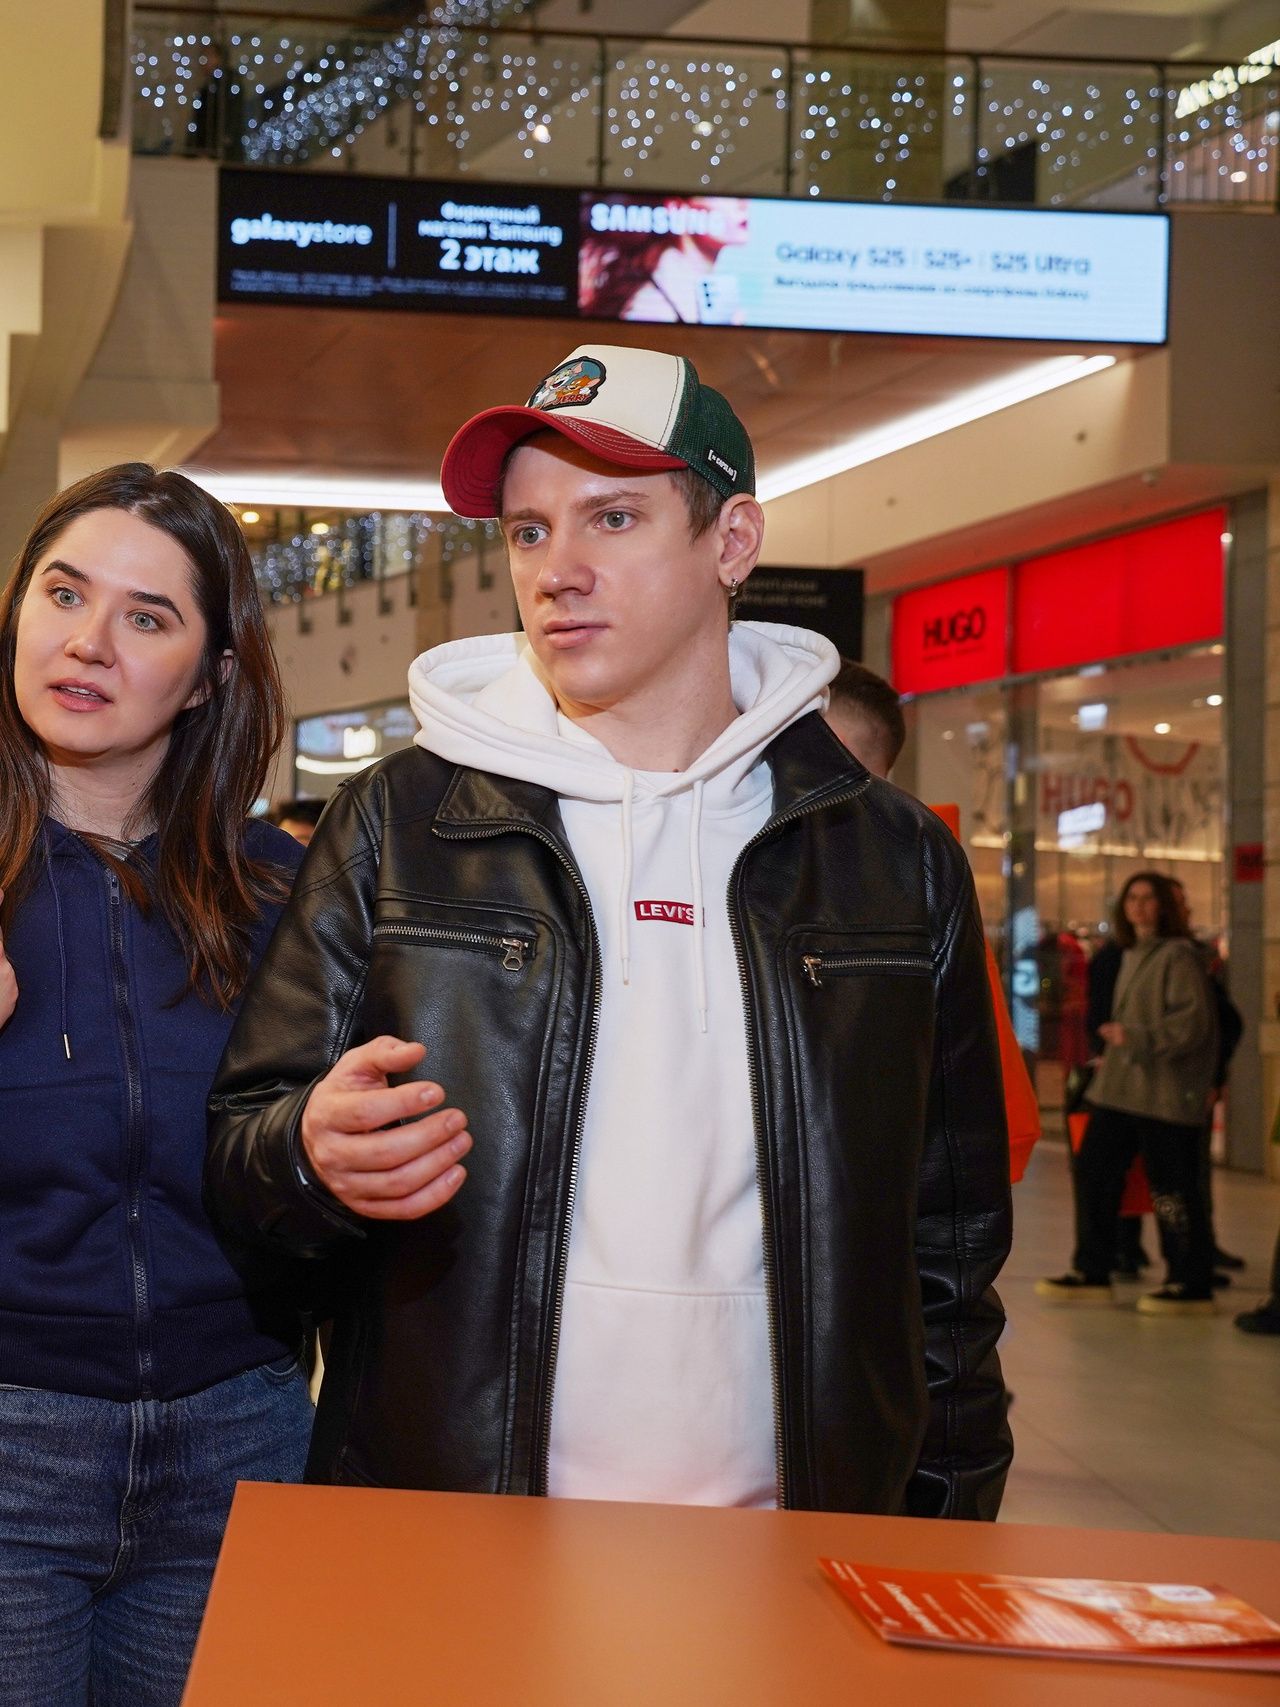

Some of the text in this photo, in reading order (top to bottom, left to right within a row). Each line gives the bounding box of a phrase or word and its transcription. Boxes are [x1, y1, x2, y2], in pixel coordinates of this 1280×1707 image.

[591, 203, 724, 236] SAMSUNG
[439, 239, 540, 274] 2 этаж
[776, 242, 859, 271] Galaxy
[868, 247, 905, 268] S25
[992, 250, 1029, 273] S25
[1034, 253, 1090, 275] Ultra
[923, 605, 987, 649] HUGO
